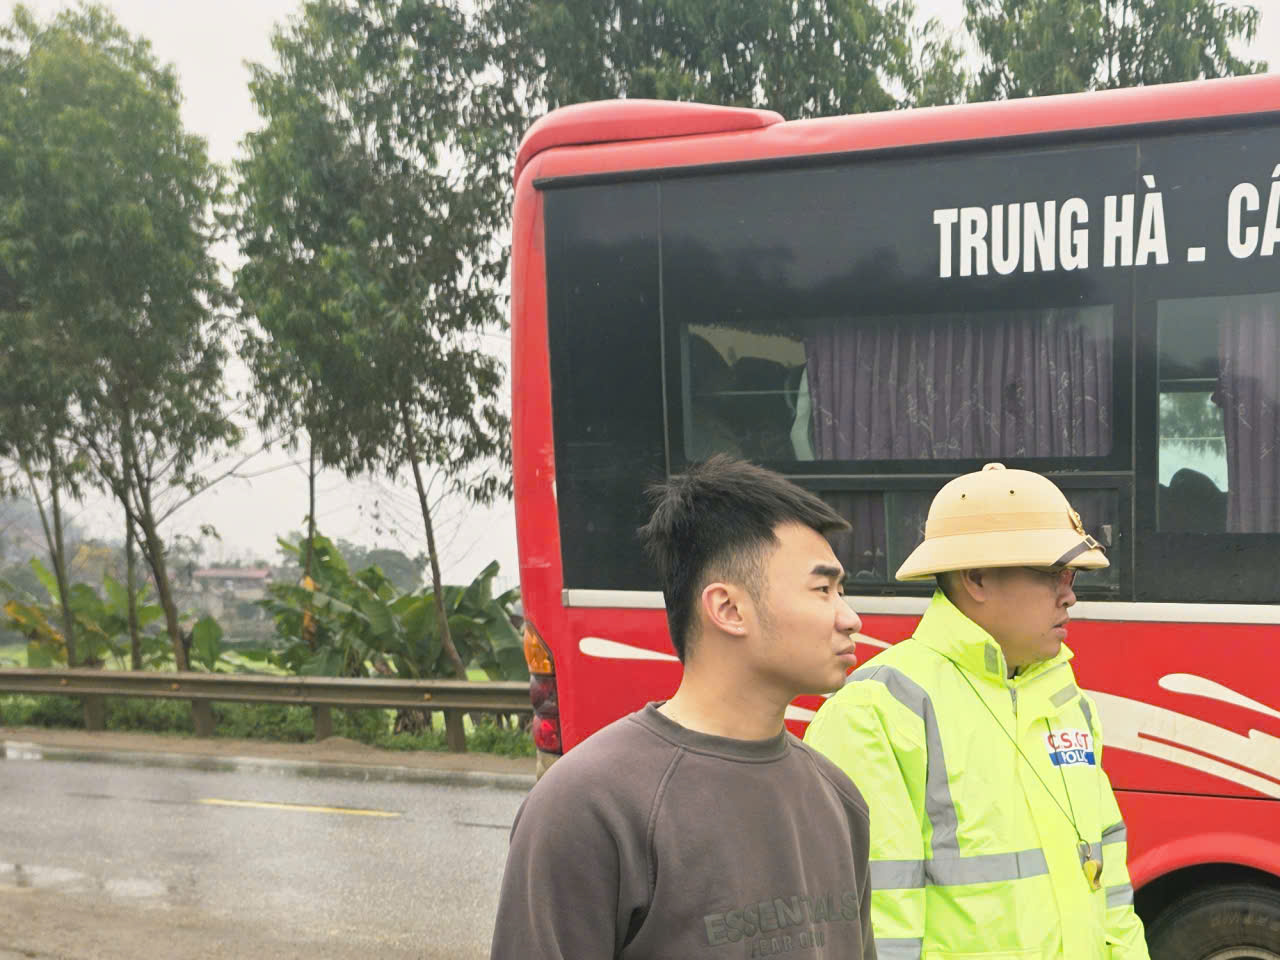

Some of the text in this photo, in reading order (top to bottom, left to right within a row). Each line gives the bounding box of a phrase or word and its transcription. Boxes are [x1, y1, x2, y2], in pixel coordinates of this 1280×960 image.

[933, 197, 1089, 278] TRUNG
[1103, 174, 1169, 268] HÀ
[703, 892, 858, 947] ESSENALS
